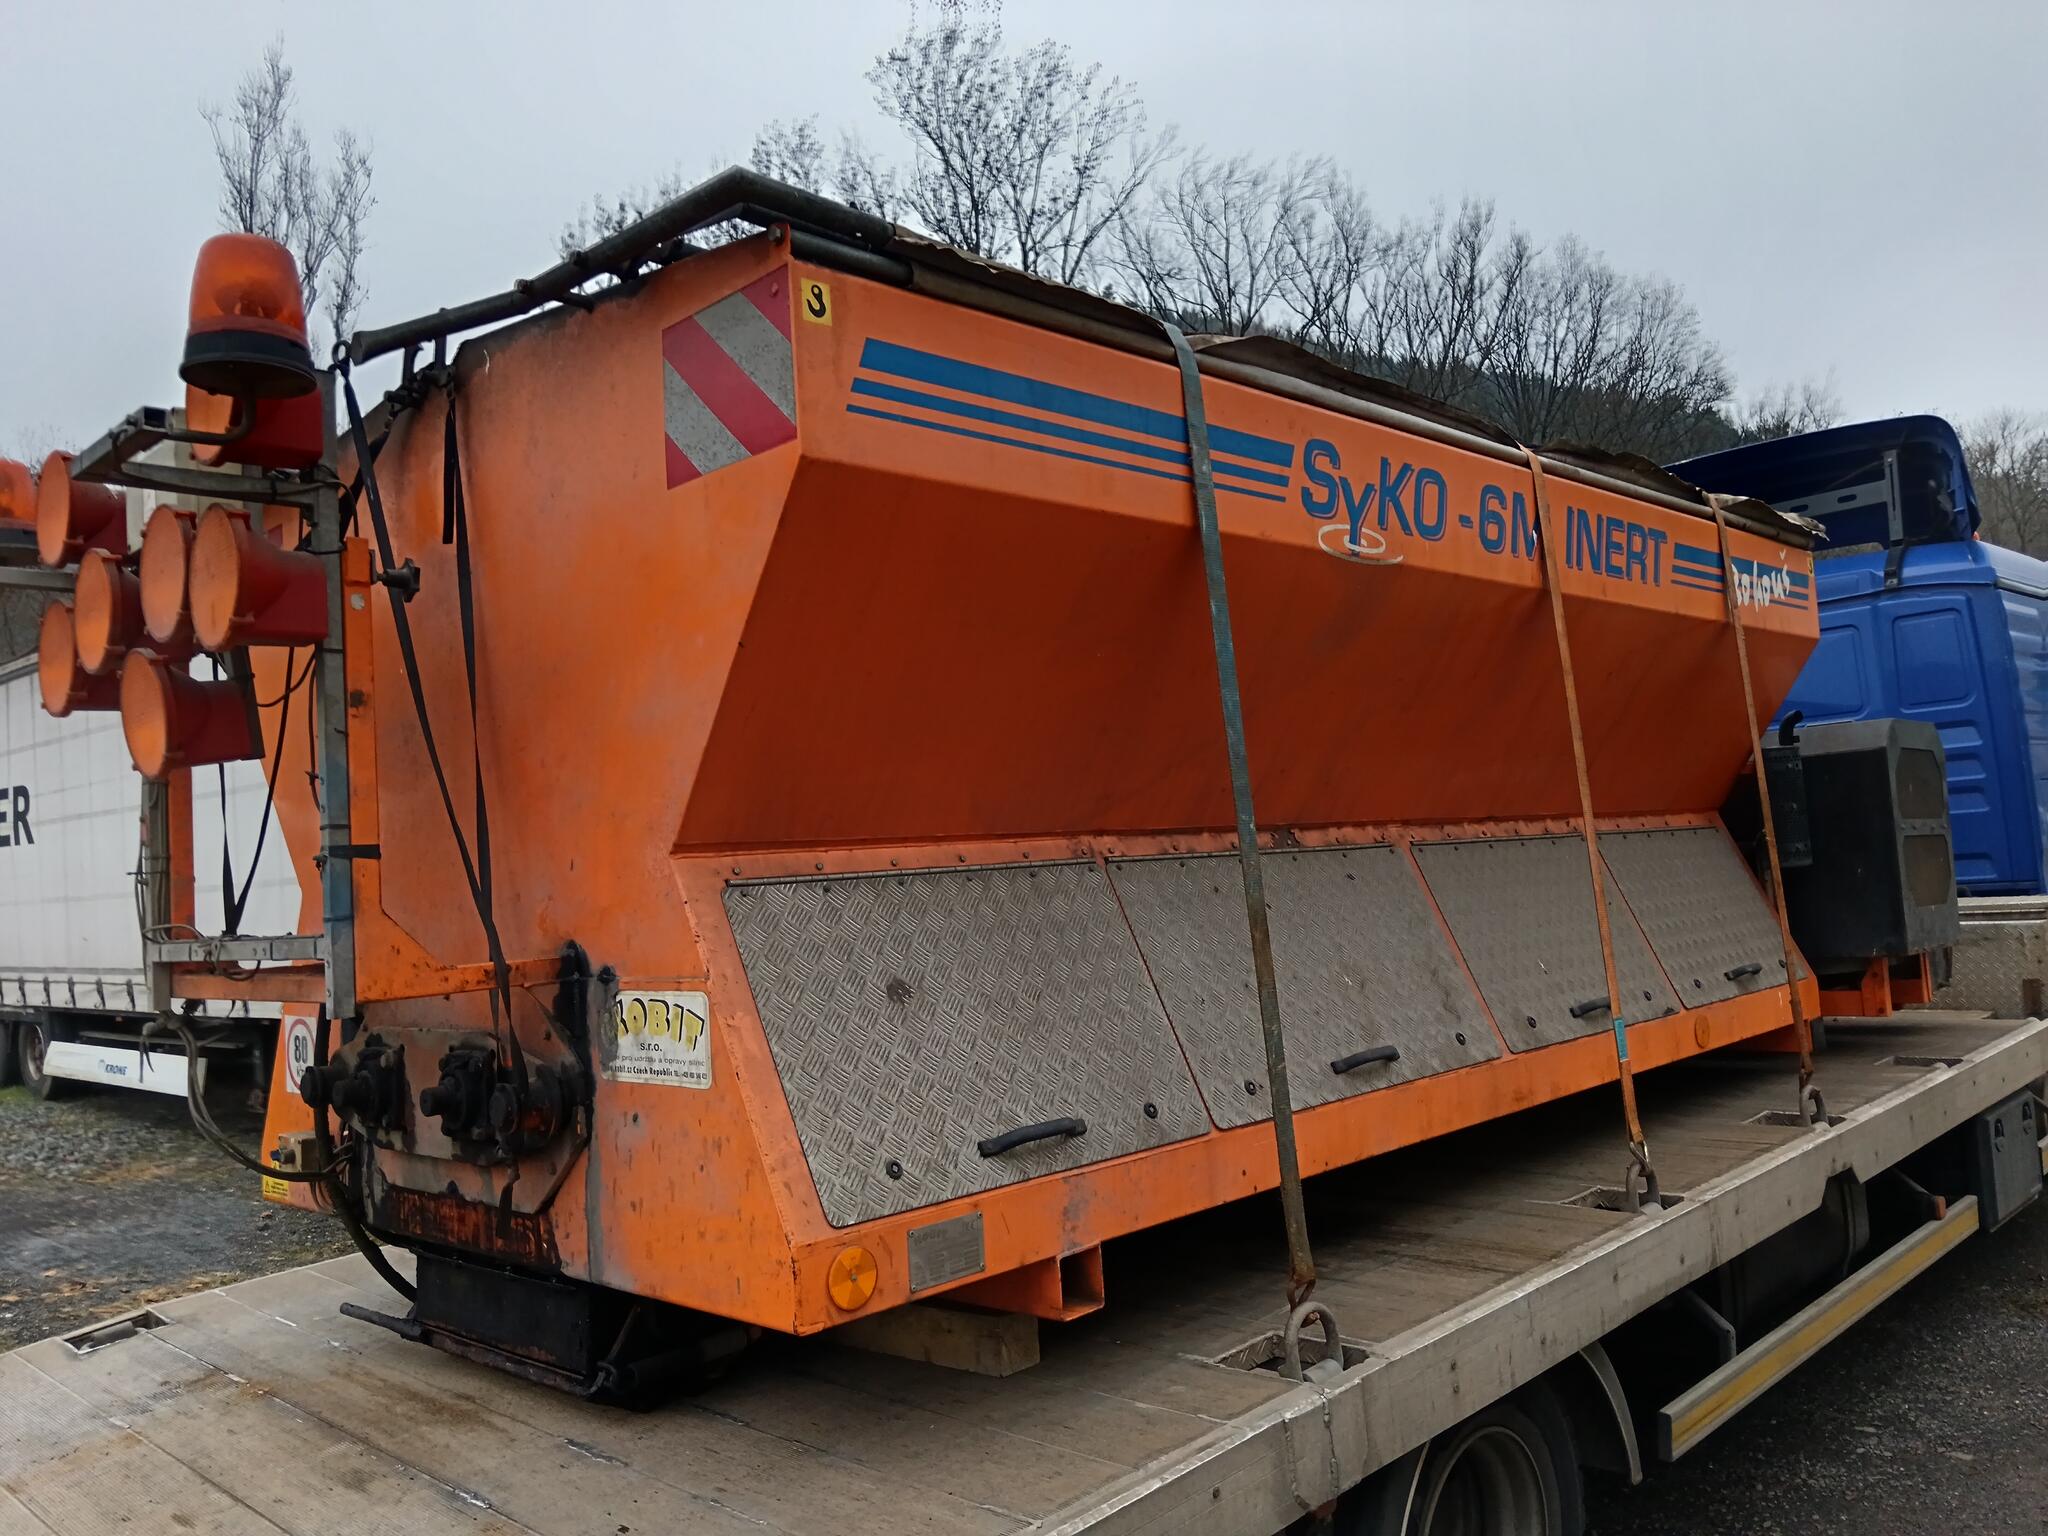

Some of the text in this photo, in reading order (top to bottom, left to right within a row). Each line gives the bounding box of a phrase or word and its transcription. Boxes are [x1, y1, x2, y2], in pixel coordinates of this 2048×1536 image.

[1566, 505, 1668, 587] INERT
[294, 1034, 308, 1064] 80
[640, 1042, 662, 1052] s.r.o.
